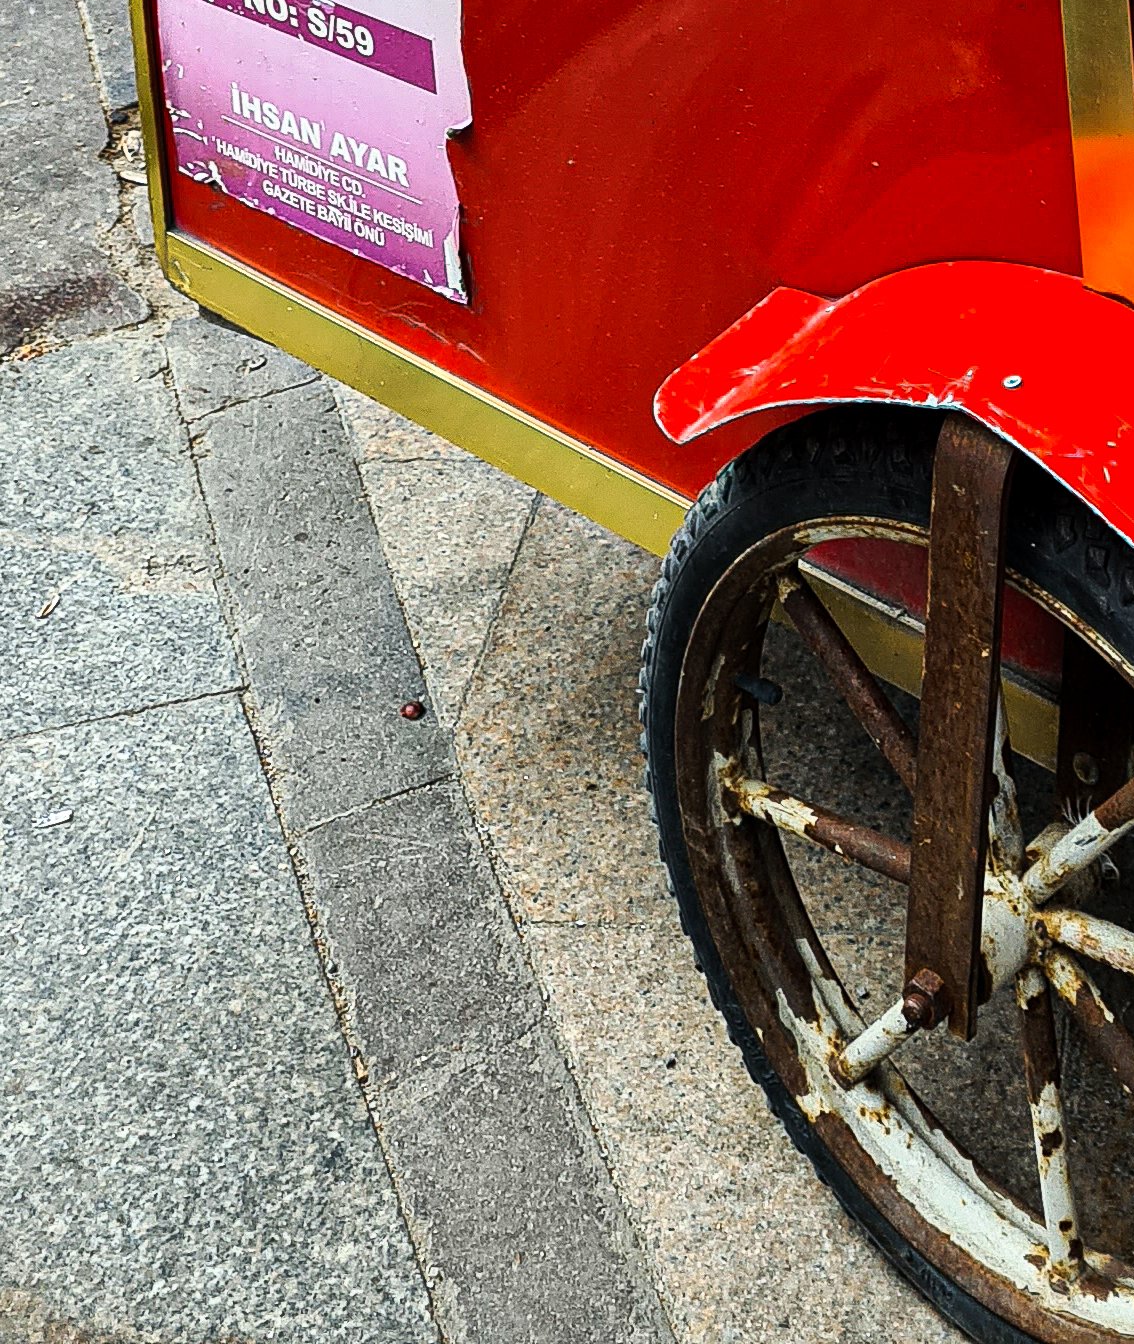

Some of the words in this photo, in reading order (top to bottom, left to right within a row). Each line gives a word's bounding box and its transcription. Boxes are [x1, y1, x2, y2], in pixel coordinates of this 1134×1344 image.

[307, 7, 375, 57] S/59
[230, 81, 322, 149] İHSAN
[329, 132, 409, 188] AYAR
[274, 145, 340, 187] HAMİDİYE
[341, 178, 366, 199] CD.
[262, 180, 316, 216] GAZETE
[354, 220, 386, 247] ÖNÜ
[279, 166, 326, 201] TÜRBE
[372, 208, 434, 248] KESİŞİMİ
